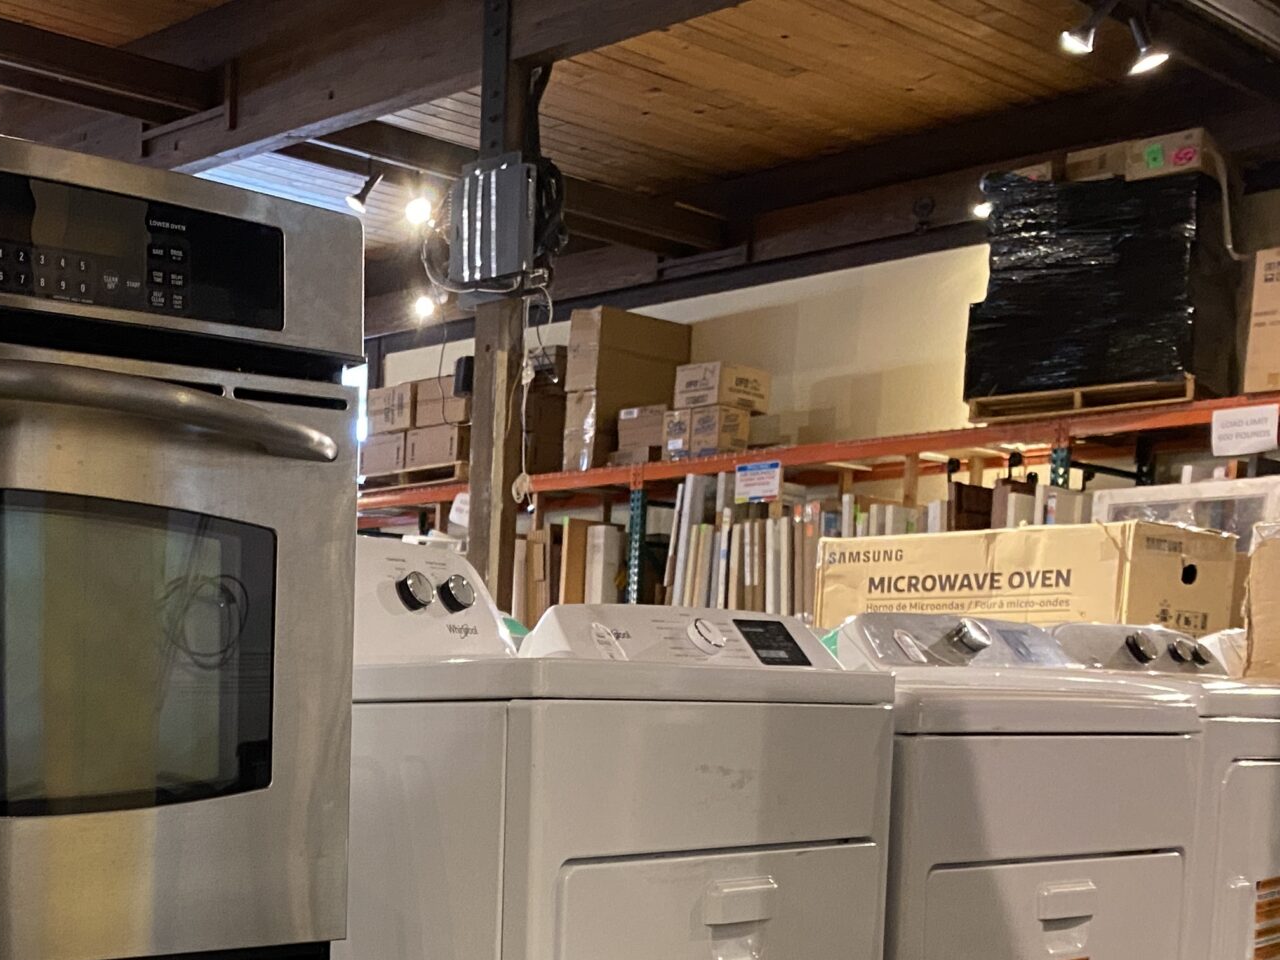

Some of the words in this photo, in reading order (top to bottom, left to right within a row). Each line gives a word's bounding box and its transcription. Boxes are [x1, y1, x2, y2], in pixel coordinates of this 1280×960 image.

[149, 219, 170, 229] LOWER
[170, 222, 186, 231] OVEN
[20, 252, 24, 261] 2
[39, 255, 45, 265] 3
[60, 258, 65, 268] 4
[80, 261, 86, 271] 5
[20, 275, 25, 284] 7
[39, 278, 45, 288] 8
[60, 281, 66, 290] 9
[80, 284, 86, 293] 0
[828, 549, 904, 564] SAMSUNG
[868, 572, 1003, 593] MICROWAVE
[1008, 568, 1072, 589] OVEN
[866, 602, 894, 612] Horno
[896, 602, 907, 611] de
[909, 601, 965, 612] Microondas
[974, 600, 997, 609] Four
[1006, 597, 1071, 609] micro-ondes
[446, 624, 479, 639] Whirlpool
